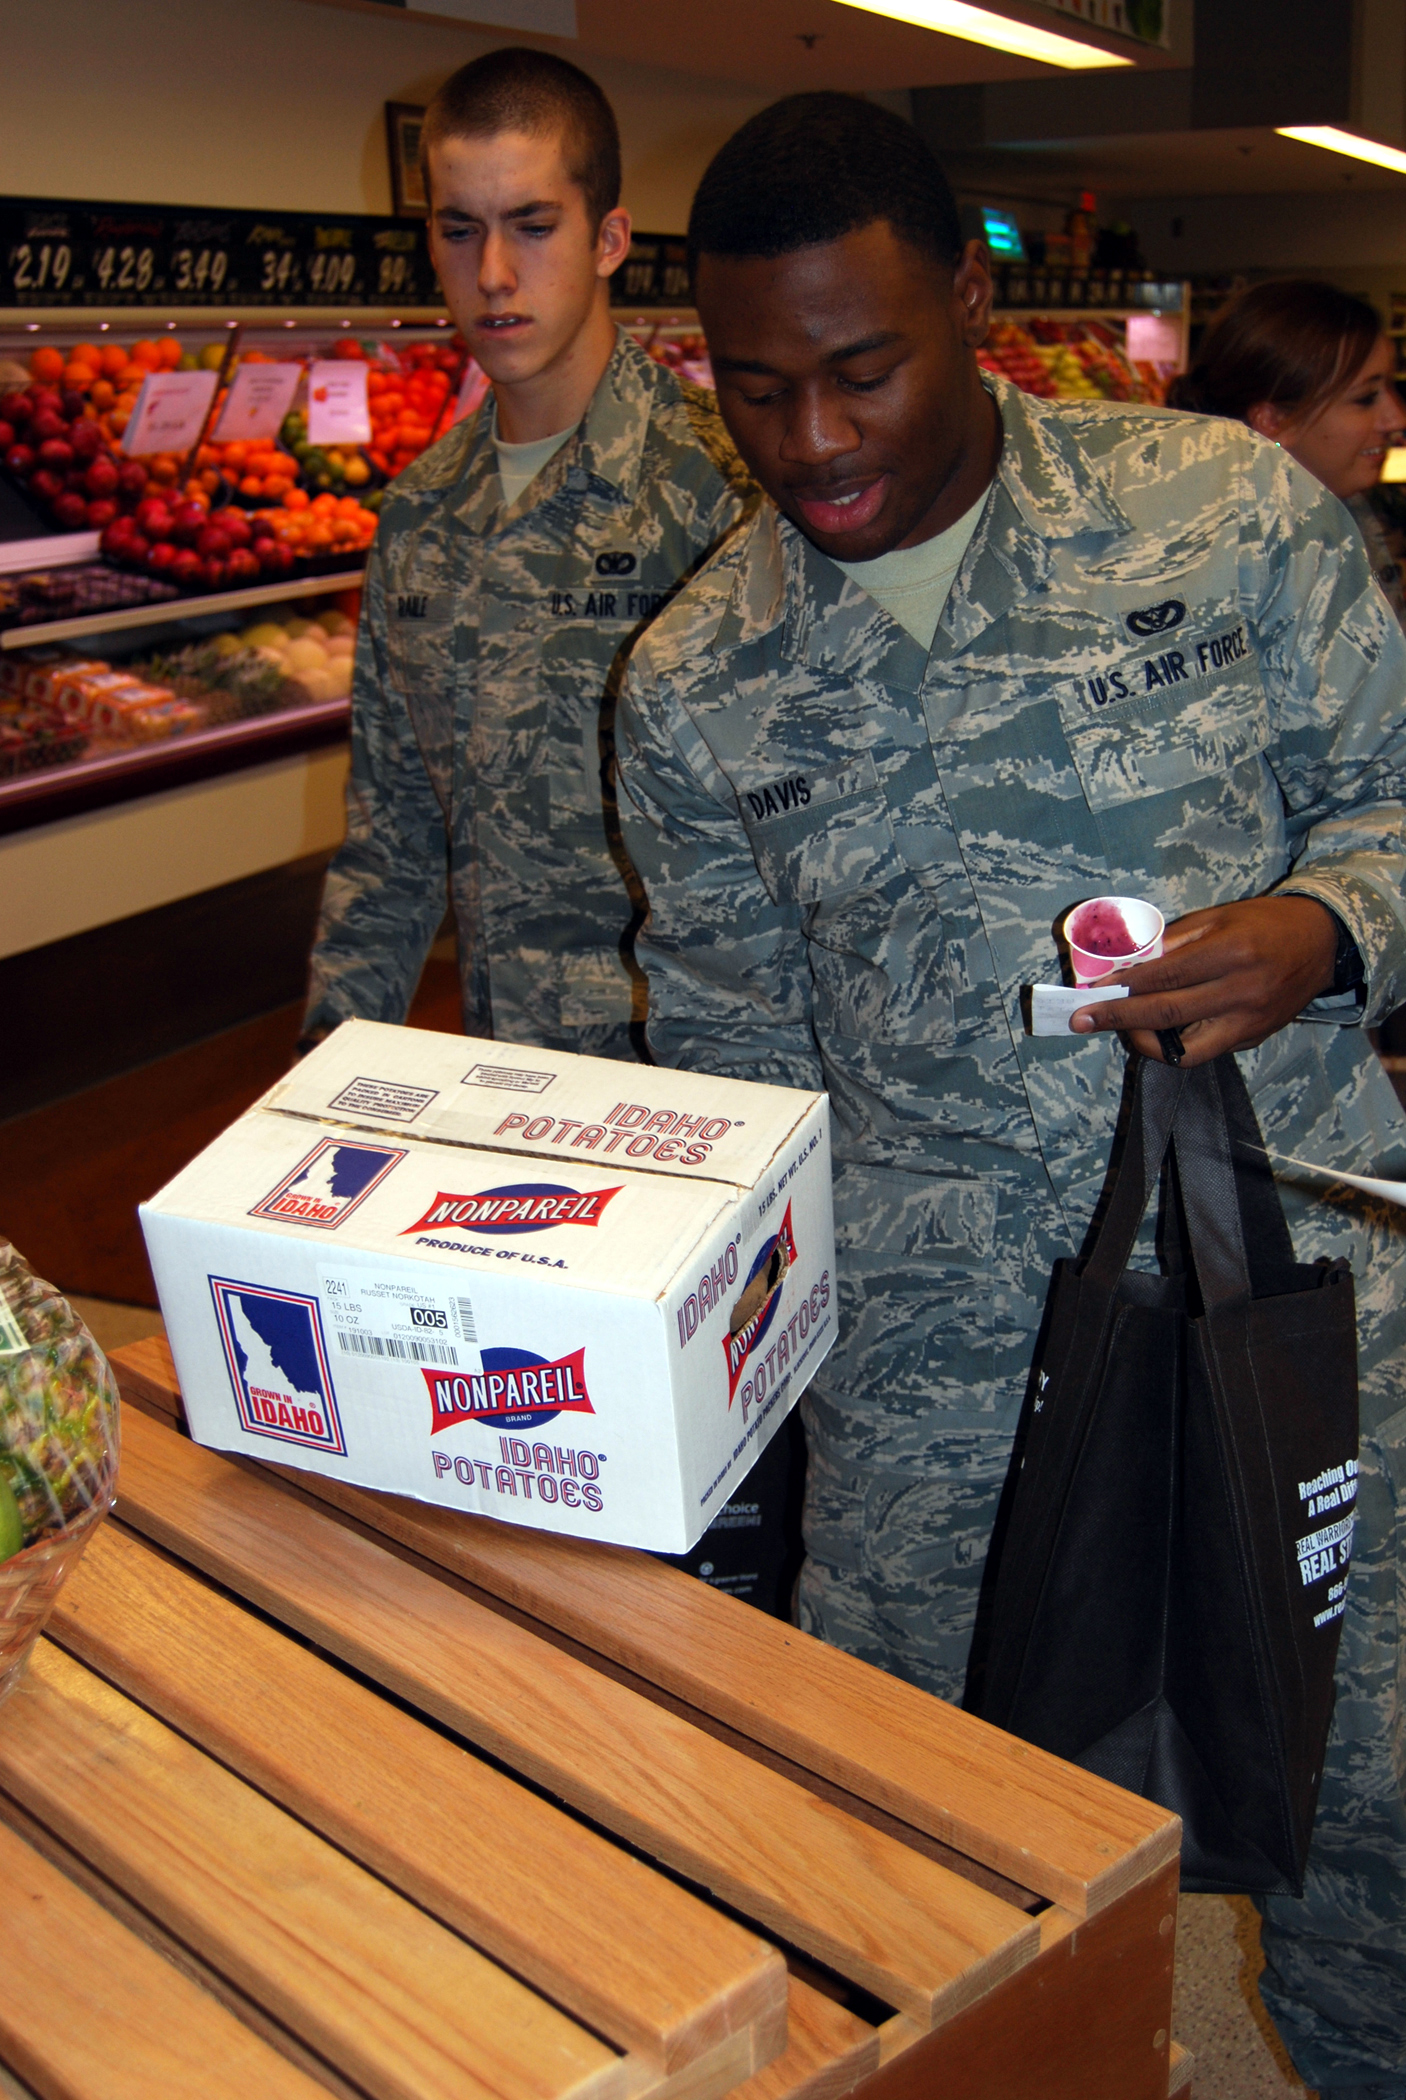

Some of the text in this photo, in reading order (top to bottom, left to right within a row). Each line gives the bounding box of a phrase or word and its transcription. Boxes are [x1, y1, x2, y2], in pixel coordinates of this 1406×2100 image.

[552, 593, 576, 616] U.S.
[585, 592, 616, 617] AIR
[1088, 627, 1247, 706] U.S. AIR FORCE
[746, 776, 812, 820] DAVIS
[493, 1112, 713, 1166] POTATOES
[285, 1192, 314, 1202] GROWN
[758, 1203, 767, 1217] 15
[778, 1174, 788, 1192] NET
[271, 1198, 339, 1220] IDAHO
[426, 1195, 601, 1223] NONPAREIL
[415, 1237, 569, 1269] PRODUCE OF U.S.A.
[325, 1279, 348, 1296] 2241
[360, 1289, 435, 1303] RUSSET NORKOTAH
[374, 1283, 418, 1294] NONPAREIL
[332, 1302, 363, 1313] 15 LBS
[334, 1314, 360, 1325] 10 OZ
[413, 1309, 447, 1327] 005
[348, 1327, 373, 1336] 191003
[741, 1271, 830, 1425] POTATOES
[250, 1386, 293, 1404] GROWN IN
[434, 1366, 585, 1413] NONPAREIL
[251, 1395, 325, 1436] IDAHO
[505, 1414, 532, 1423] BRAND
[432, 1450, 603, 1512] POTATOES
[1298, 1465, 1345, 1501] Reaching
[1308, 1499, 1316, 1518] A
[1316, 1487, 1342, 1514] Real
[1296, 1536, 1316, 1556] REAL
[1299, 1547, 1337, 1586] REAL
